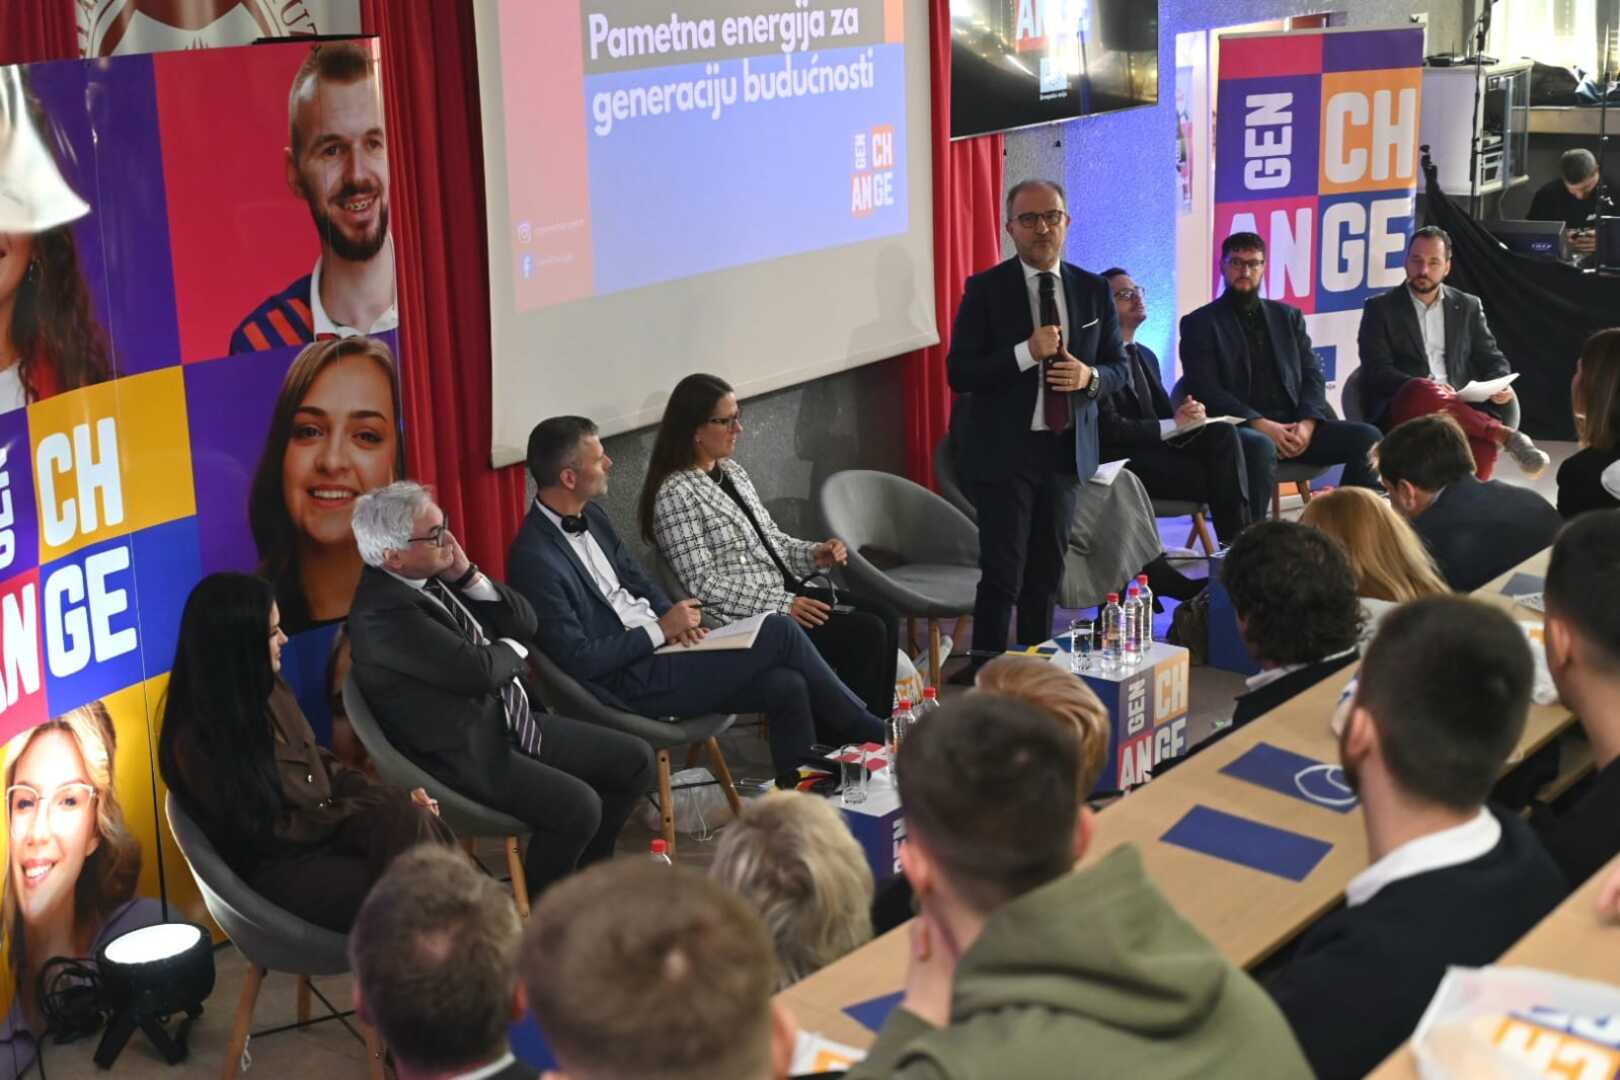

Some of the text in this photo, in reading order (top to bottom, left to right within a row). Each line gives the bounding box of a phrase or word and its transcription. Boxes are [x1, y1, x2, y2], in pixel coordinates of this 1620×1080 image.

[588, 0, 859, 60] Pametna energija za
[593, 47, 875, 137] generaciju budućnosti
[854, 132, 893, 169] GEN CH
[1244, 88, 1417, 190] GEN CH
[851, 171, 894, 212] AN GE
[1321, 197, 1417, 293] GE
[36, 416, 124, 548] CH
[0, 545, 138, 714] N GE
[1127, 660, 1188, 736] GEN CH
[1119, 735, 1153, 795] AN
